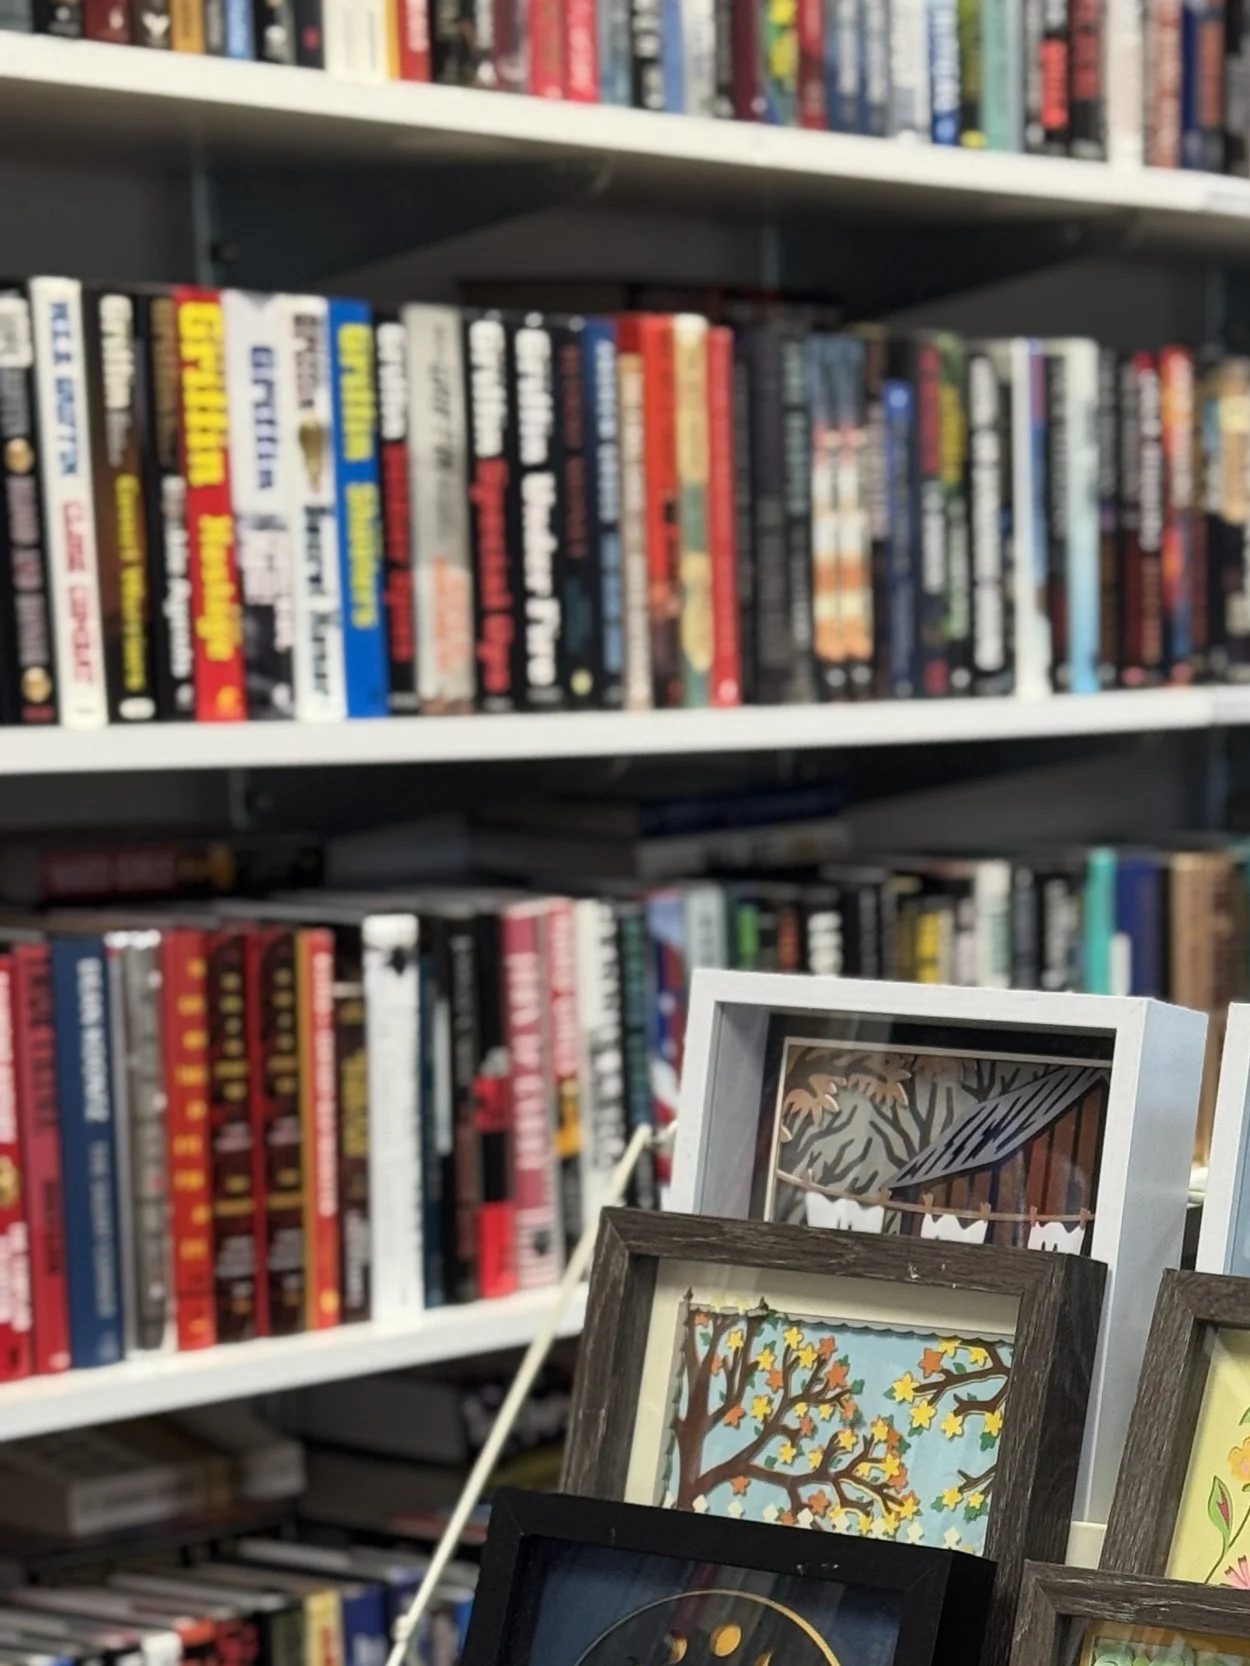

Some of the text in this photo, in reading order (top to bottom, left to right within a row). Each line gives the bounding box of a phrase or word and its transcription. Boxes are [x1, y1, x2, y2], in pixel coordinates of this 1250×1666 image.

[178, 301, 228, 487] Griffin
[337, 323, 375, 462] Griffin
[468, 321, 507, 458] Griffin
[516, 329, 553, 465] Griffin
